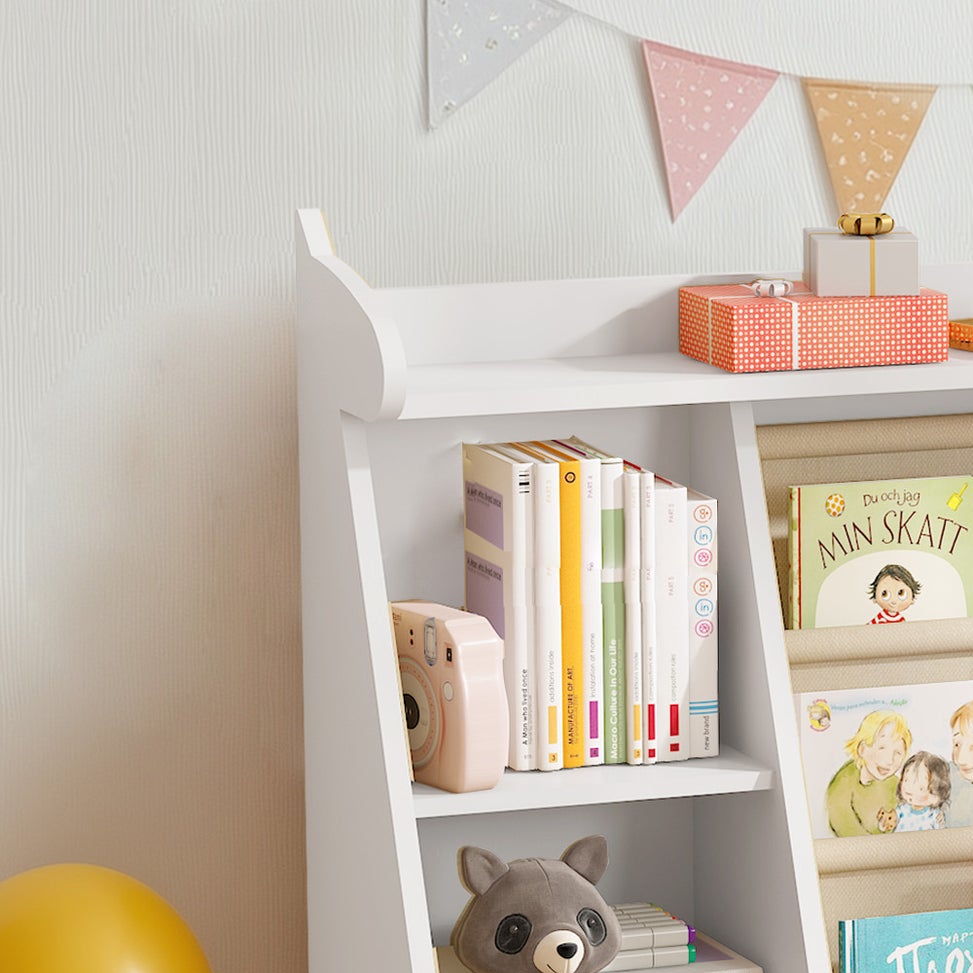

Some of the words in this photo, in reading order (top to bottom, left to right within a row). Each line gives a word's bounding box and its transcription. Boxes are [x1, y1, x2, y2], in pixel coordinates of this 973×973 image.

[863, 494, 878, 507] Du
[881, 489, 900, 502] och
[897, 489, 921, 507] jag
[818, 516, 873, 569] MIN
[882, 510, 968, 555] SKATT
[610, 680, 617, 688] In
